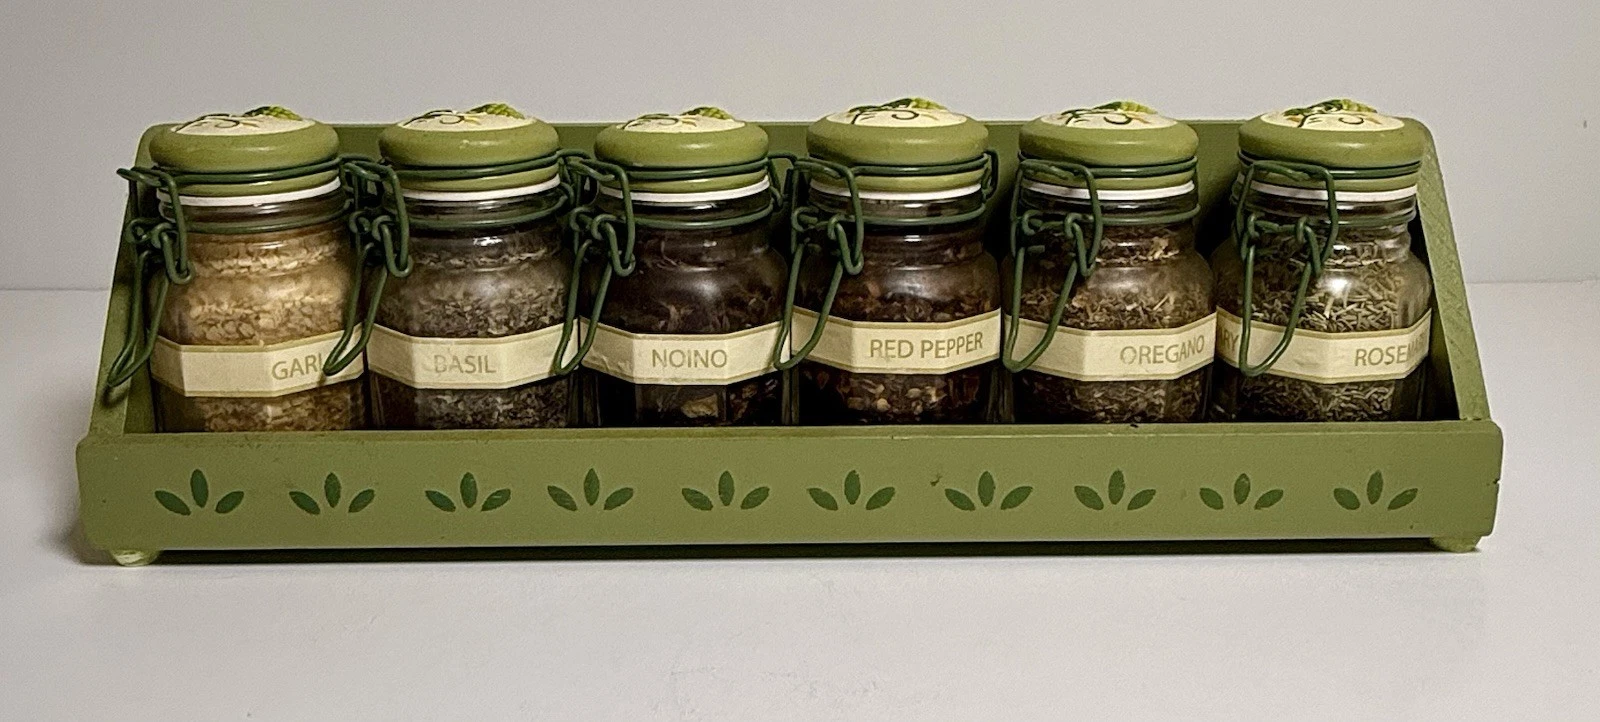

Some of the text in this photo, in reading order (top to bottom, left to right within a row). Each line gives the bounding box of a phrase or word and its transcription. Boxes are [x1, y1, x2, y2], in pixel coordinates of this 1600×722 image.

[870, 331, 983, 359] RED PEPPER
[1119, 334, 1205, 365] OREGANO
[433, 354, 497, 374] BASIL
